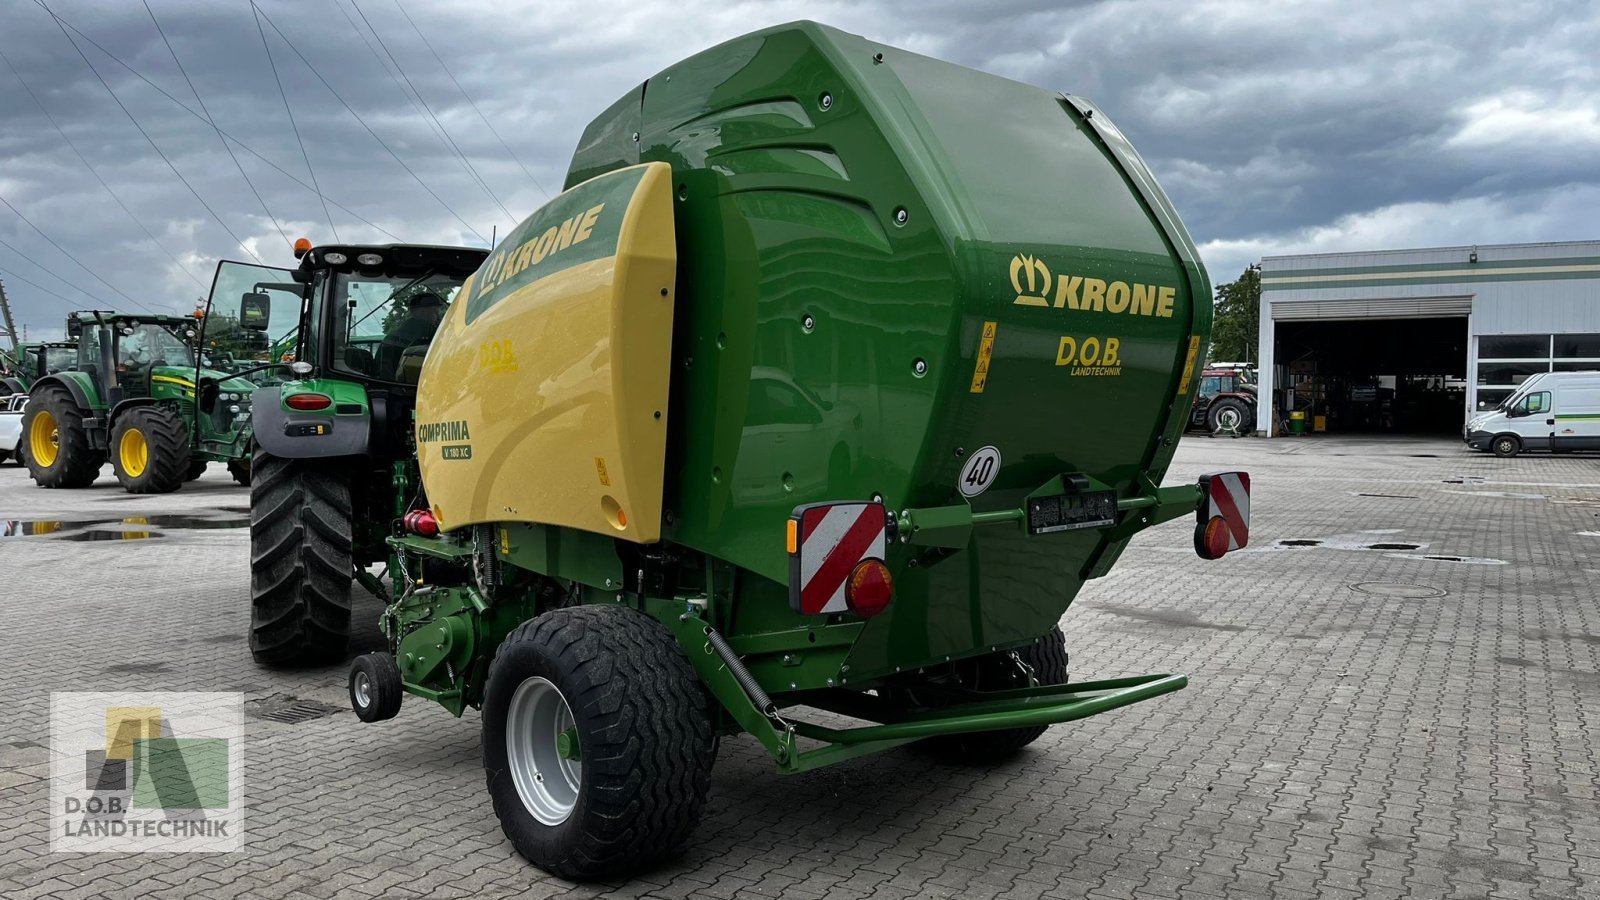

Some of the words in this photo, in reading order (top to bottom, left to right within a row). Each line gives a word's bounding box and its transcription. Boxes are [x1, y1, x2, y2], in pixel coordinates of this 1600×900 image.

[496, 202, 605, 286] KRONE
[1053, 274, 1176, 318] KRONE
[1055, 336, 1121, 366] D.O.B.
[1071, 367, 1121, 376] LANDTECHNIK
[418, 420, 470, 443] COMPRIMA
[444, 448, 449, 458] V
[460, 447, 469, 457] XC
[965, 456, 994, 486] 40
